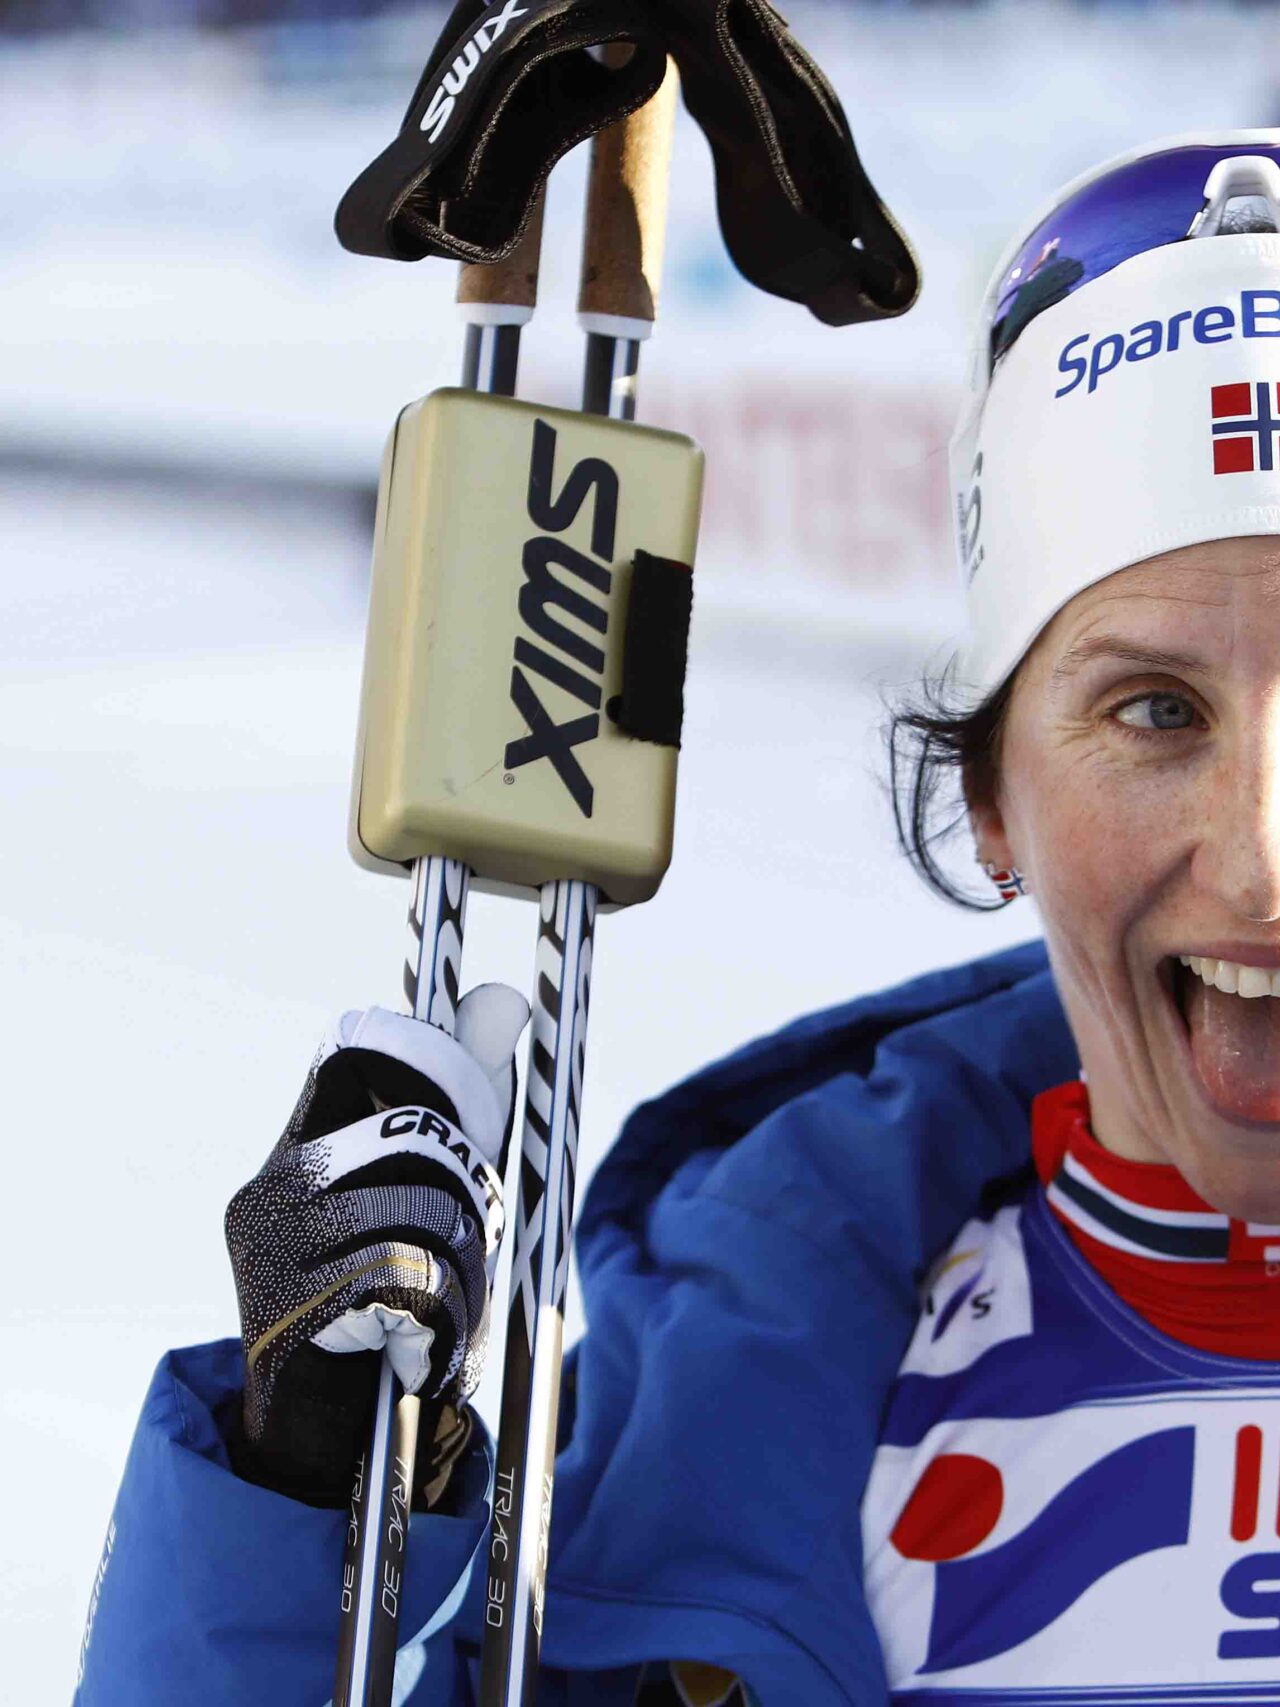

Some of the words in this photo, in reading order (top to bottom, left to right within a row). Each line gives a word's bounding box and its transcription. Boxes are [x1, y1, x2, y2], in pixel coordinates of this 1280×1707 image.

[420, 0, 529, 144] SWIX
[504, 418, 620, 819] SWIX
[380, 1109, 501, 1210] CRAFT
[348, 1453, 366, 1547] TRIAC
[388, 1456, 411, 1552] TRIAC
[492, 1467, 515, 1561] TRIAC
